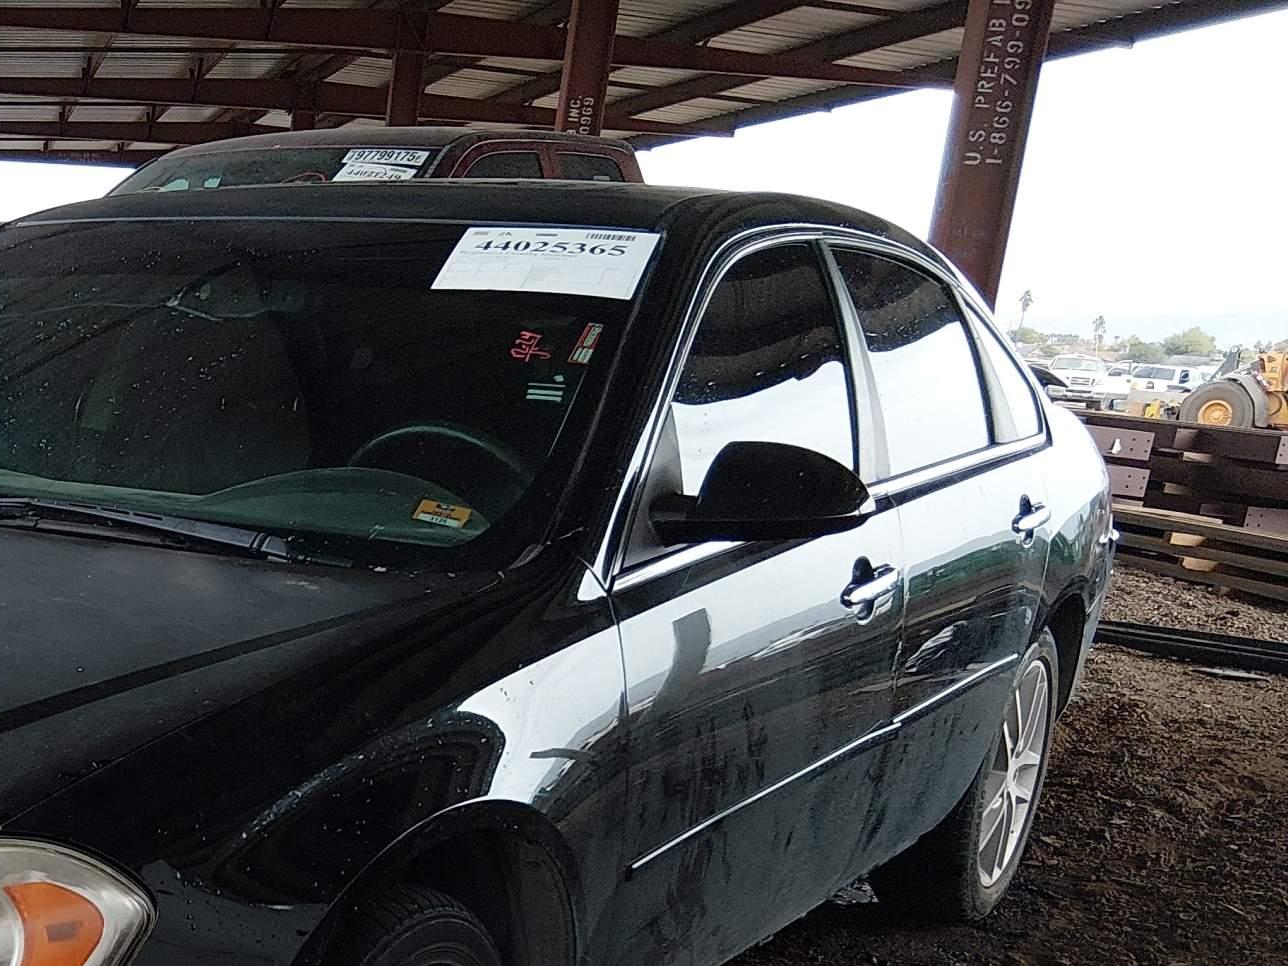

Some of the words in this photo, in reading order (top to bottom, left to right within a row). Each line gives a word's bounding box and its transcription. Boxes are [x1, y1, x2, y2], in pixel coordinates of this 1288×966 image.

[974, 18, 1007, 108] PREFAB
[567, 95, 583, 122] INC.
[354, 150, 418, 161] 97799175
[964, 123, 989, 165] U.S.
[473, 239, 629, 257] 44025365
